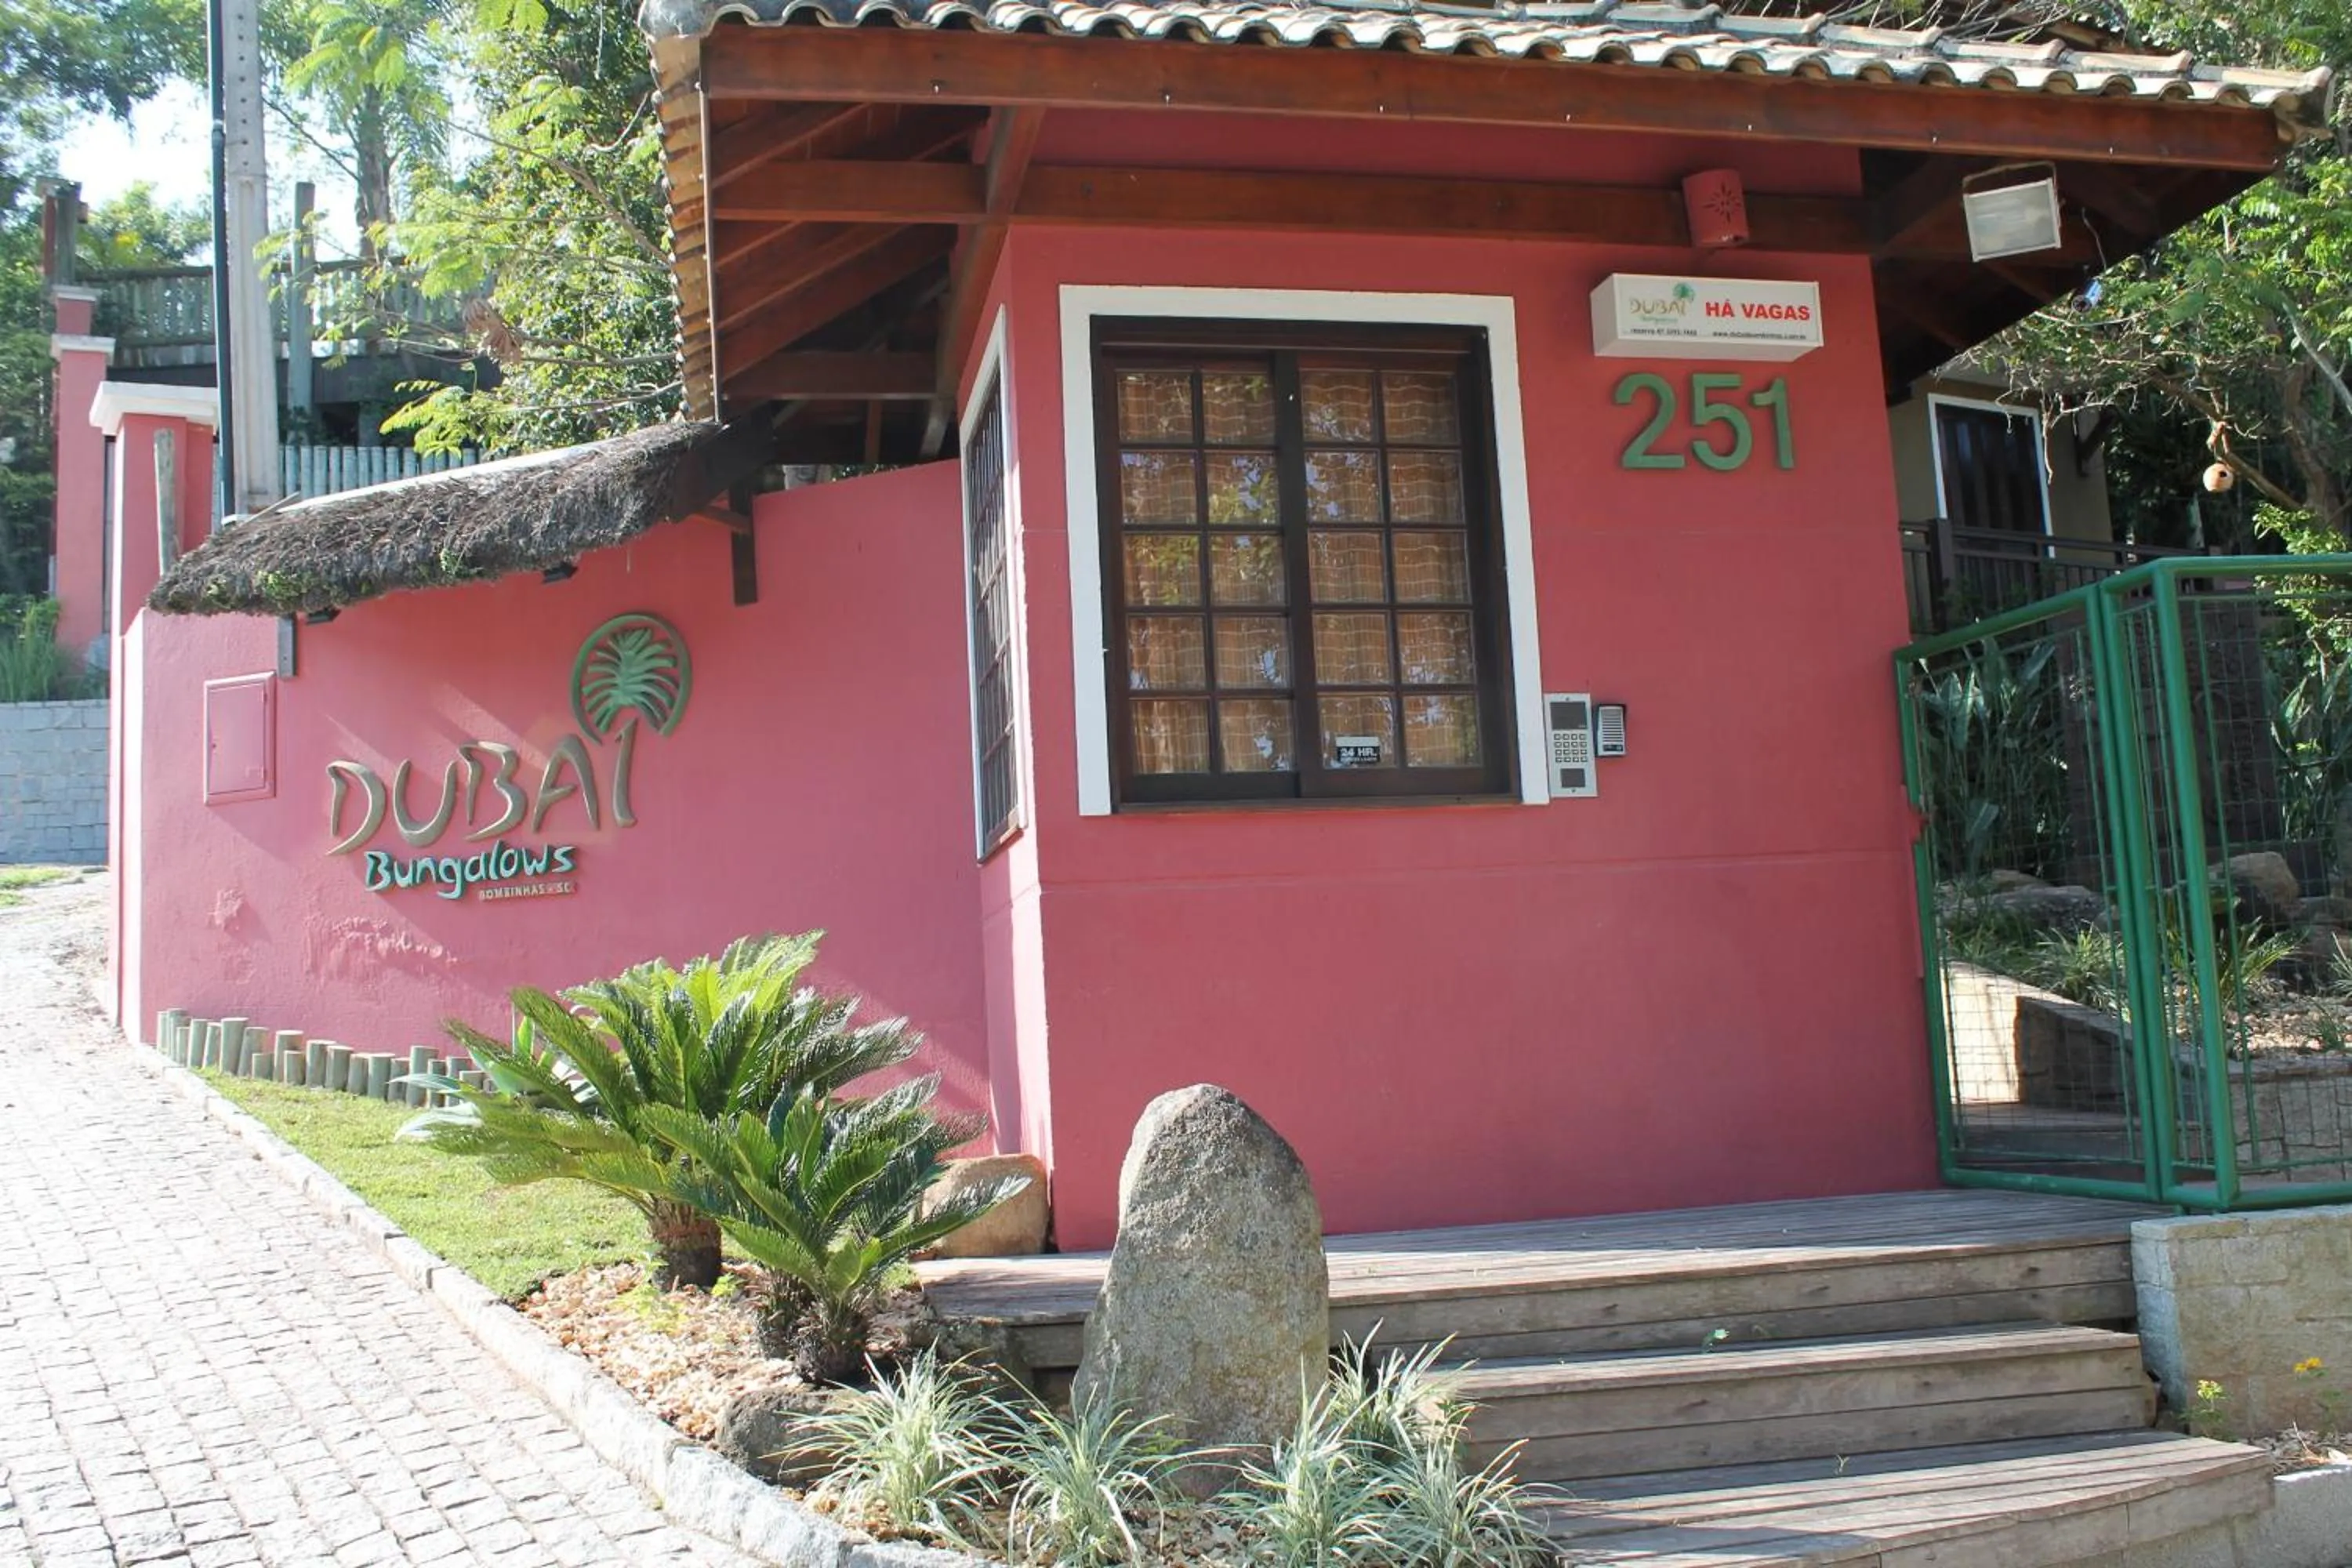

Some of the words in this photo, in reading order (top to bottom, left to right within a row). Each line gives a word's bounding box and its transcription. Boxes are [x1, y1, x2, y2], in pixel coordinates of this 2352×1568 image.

[1704, 299, 1735, 318] HÁ
[1740, 303, 1811, 321] VAGAS
[1614, 372, 1795, 470] 251
[1340, 747, 1356, 757] 24
[325, 717, 638, 856] DUBAI
[364, 840, 577, 901] Bungalows
